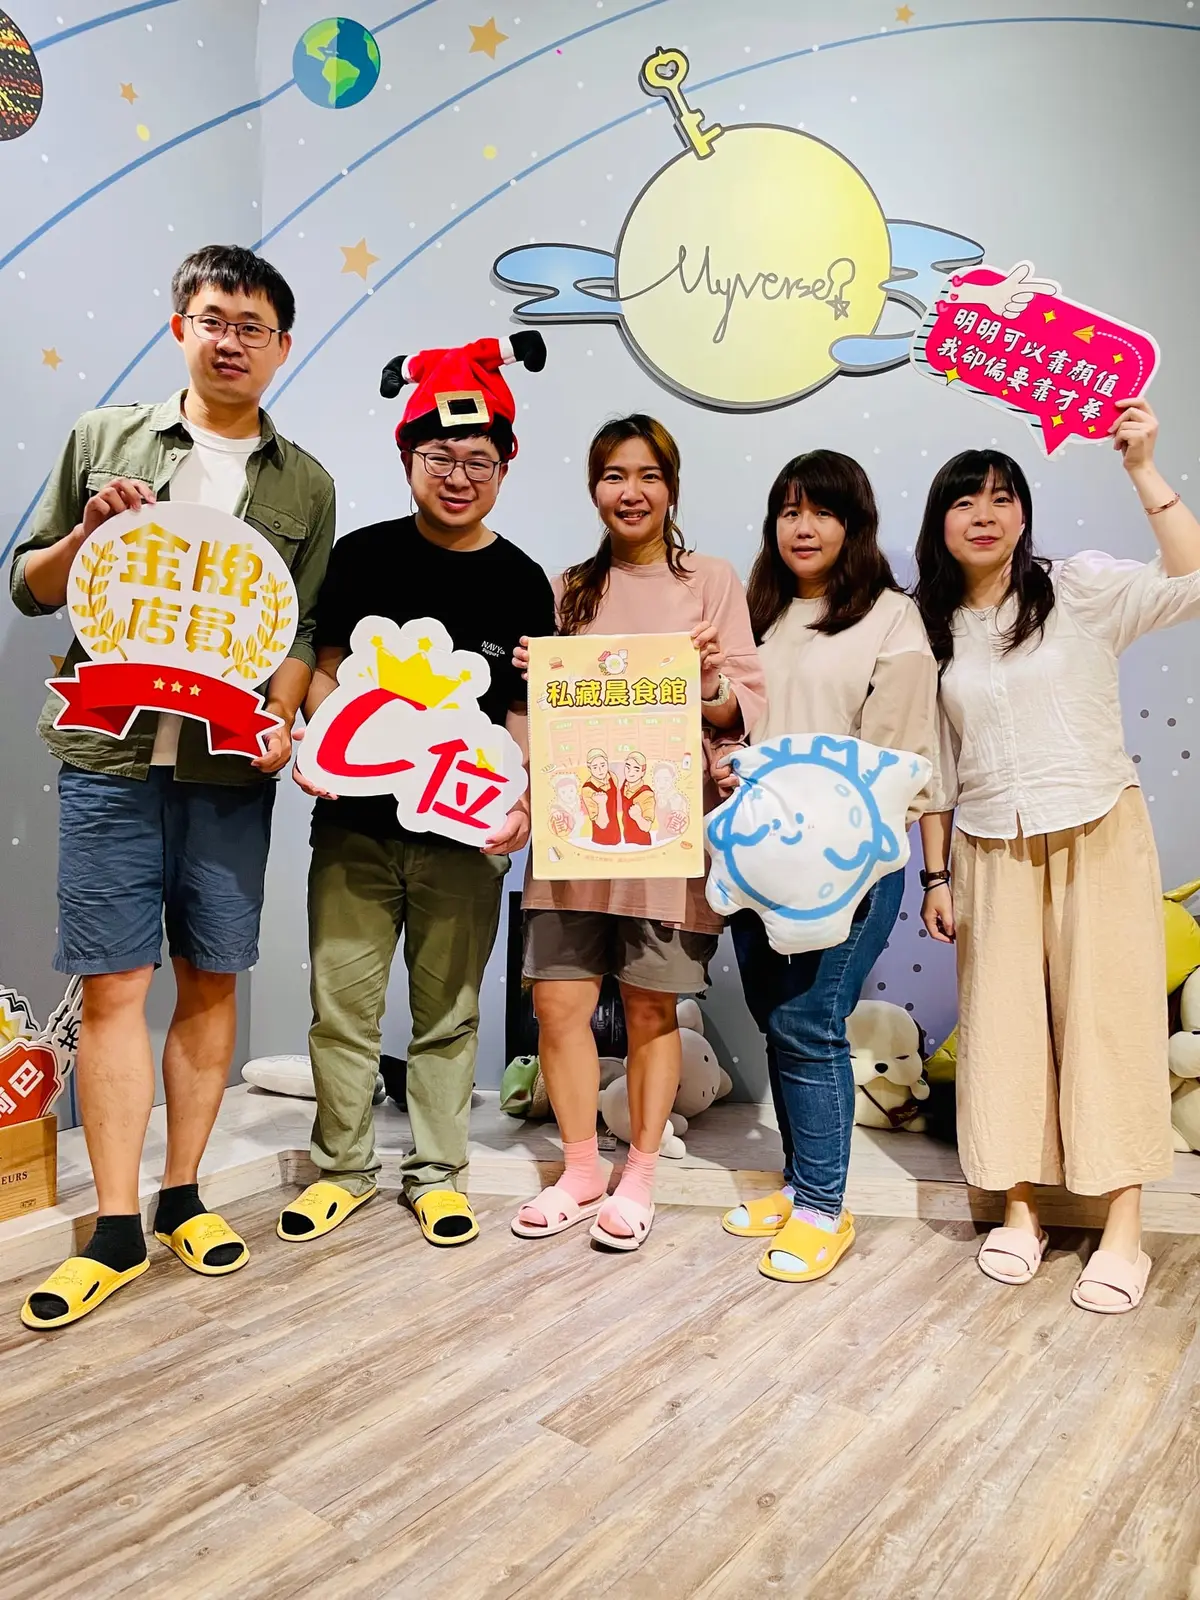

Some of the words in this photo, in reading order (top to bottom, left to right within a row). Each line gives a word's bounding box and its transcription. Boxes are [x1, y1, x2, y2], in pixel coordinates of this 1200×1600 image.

[119, 522, 263, 607] 金牌
[126, 596, 236, 655] 店員
[546, 676, 687, 708] 私藏晨食館
